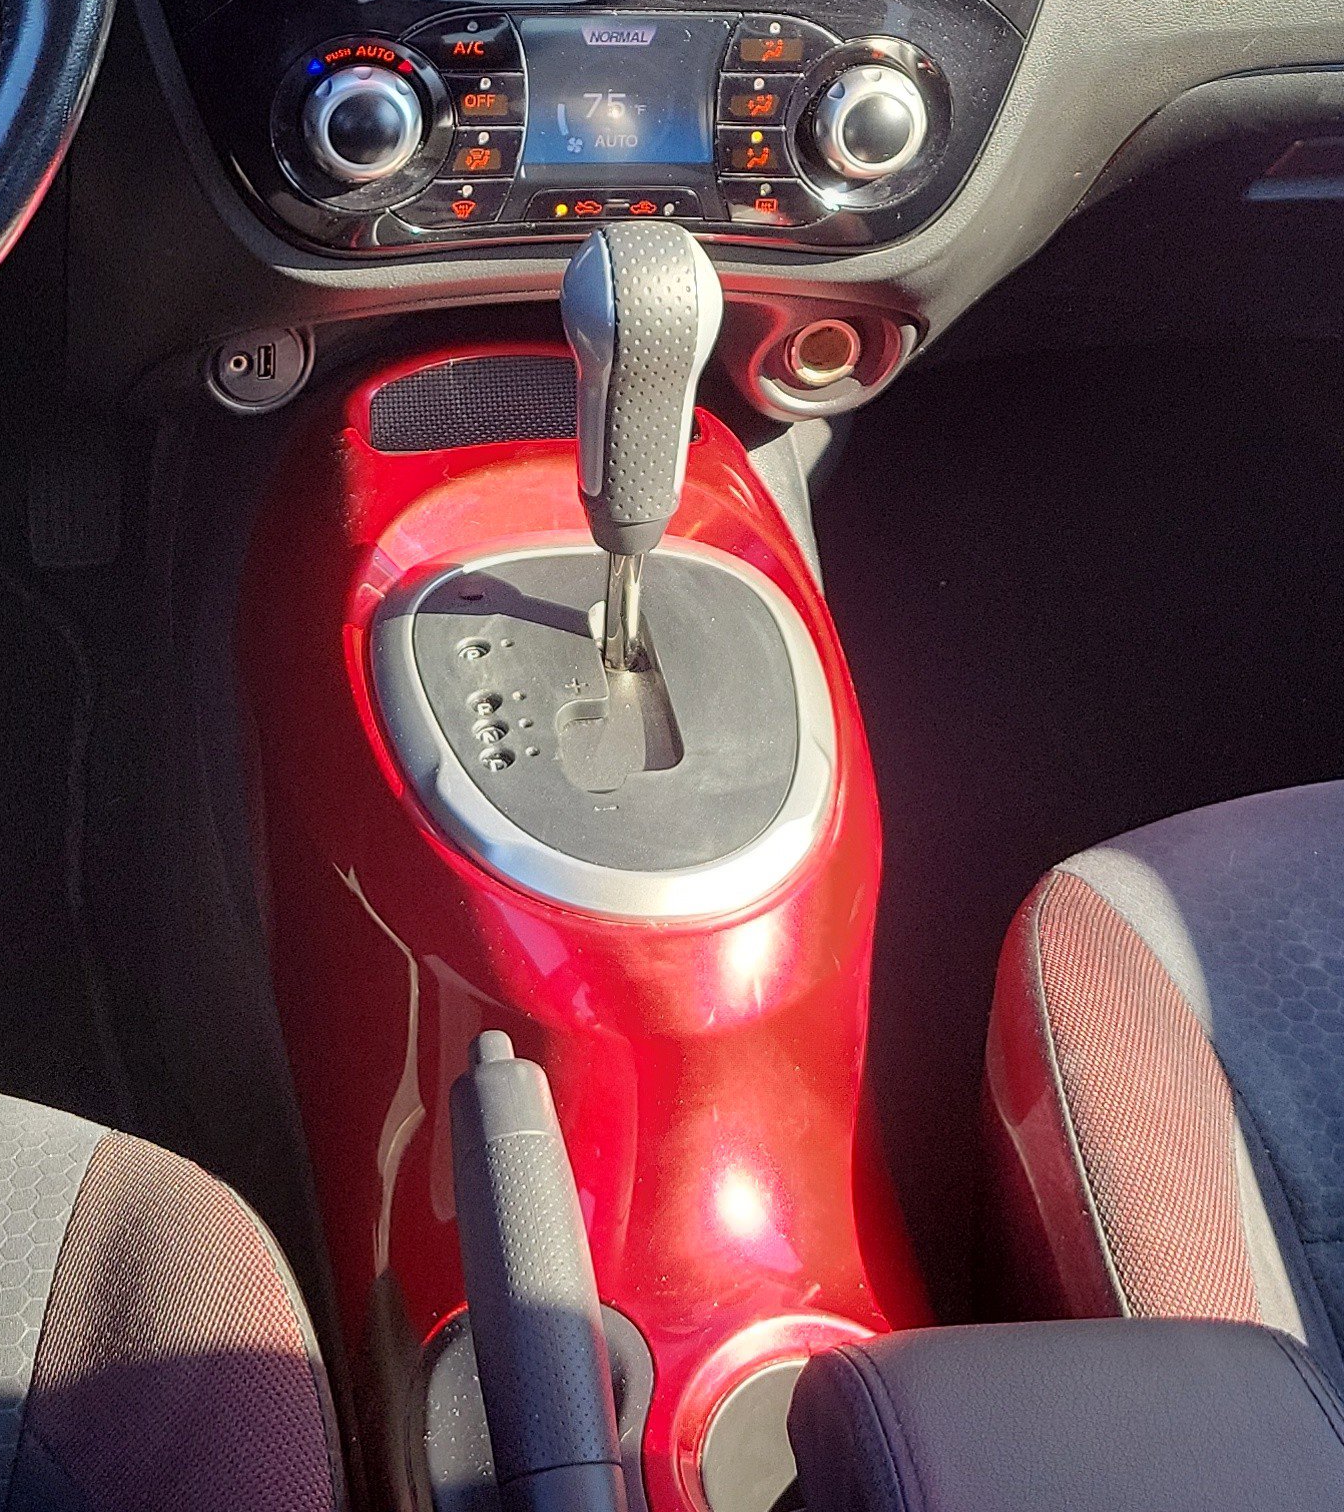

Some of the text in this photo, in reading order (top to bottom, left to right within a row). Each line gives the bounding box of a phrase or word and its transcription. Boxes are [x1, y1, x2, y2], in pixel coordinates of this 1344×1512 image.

[587, 29, 650, 44] NORMAL
[325, 45, 395, 63] PUSH AUTO
[453, 40, 484, 56] A/C
[464, 93, 496, 109] OFF
[594, 132, 639, 149] AUTO
